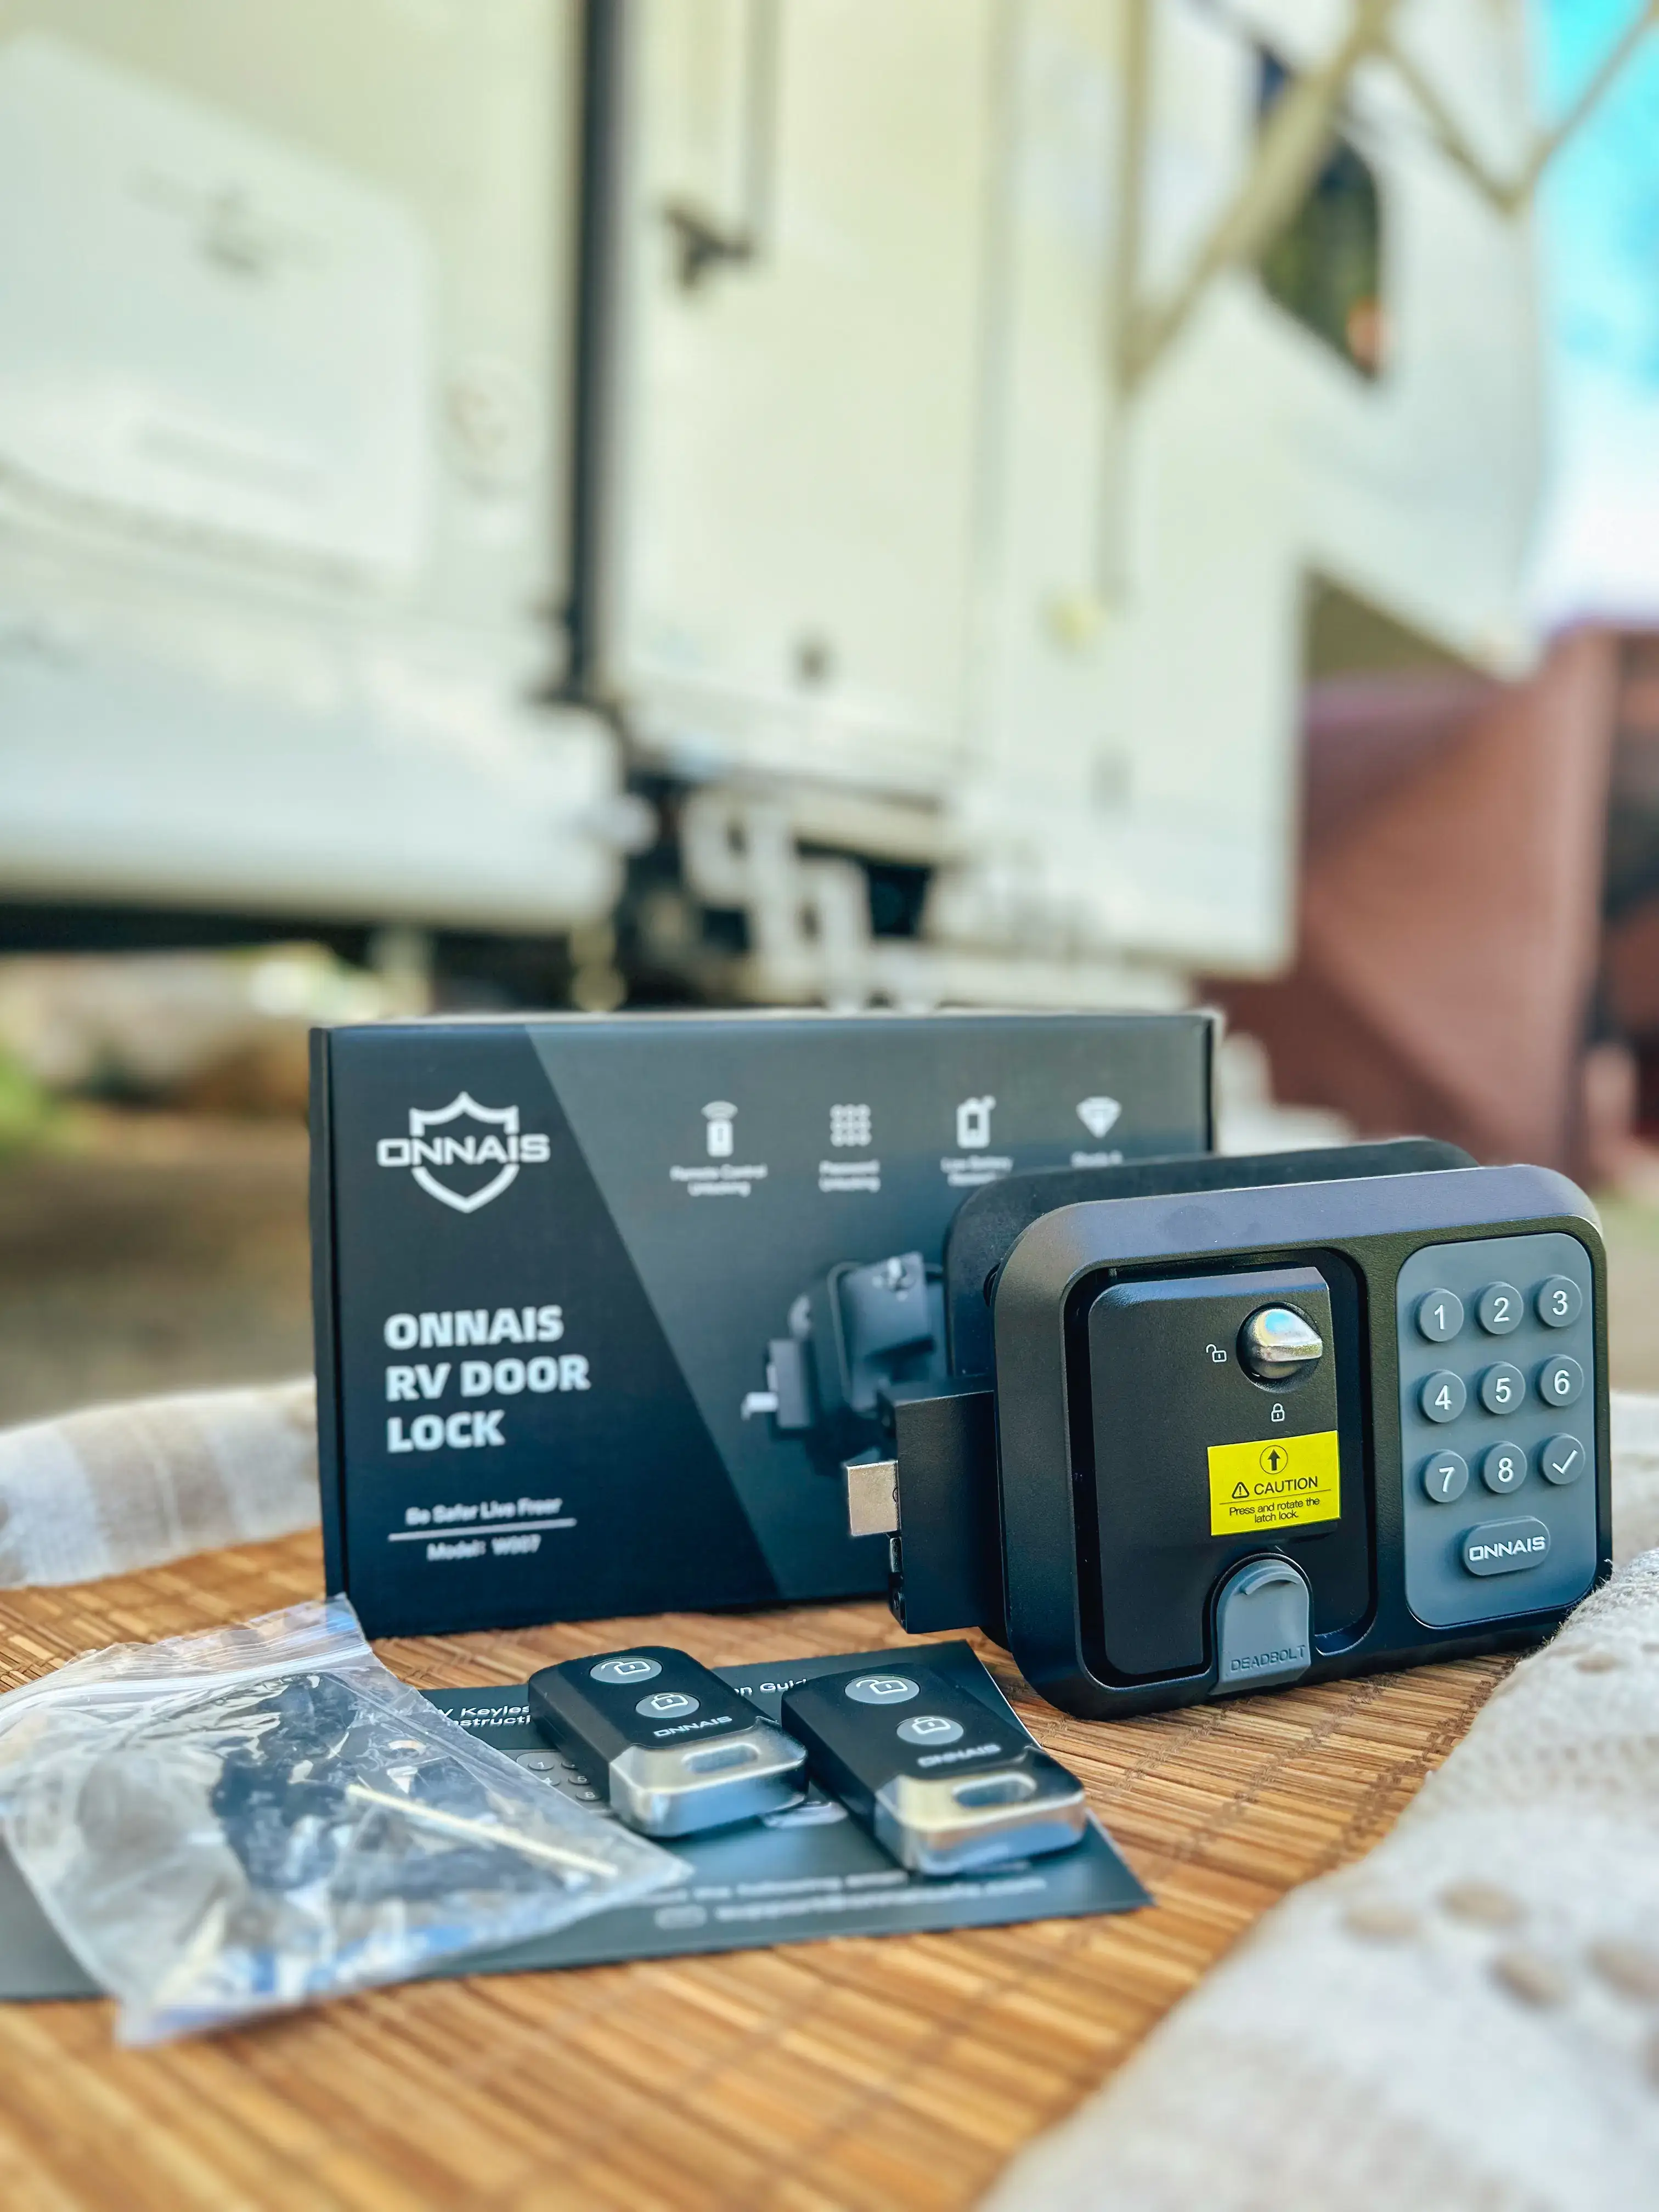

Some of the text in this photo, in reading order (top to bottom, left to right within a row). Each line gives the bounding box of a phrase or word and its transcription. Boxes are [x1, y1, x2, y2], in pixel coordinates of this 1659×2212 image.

[377, 1133, 551, 1167] ONNAIS
[1493, 1296, 1510, 1323] 2
[1553, 1290, 1568, 1316] 3
[384, 1305, 564, 1350] ONNAIS
[1434, 1305, 1445, 1330] 1
[386, 1354, 591, 1402] RV DOOR
[1495, 1377, 1511, 1403] 5
[1554, 1369, 1570, 1395] 6
[1435, 1385, 1452, 1410] 4
[387, 1409, 506, 1453] LOCK
[1438, 1466, 1454, 1493] 7
[1498, 1457, 1513, 1483] 8
[1254, 1476, 1318, 1495] CAUTION
[1229, 1497, 1320, 1516] Press and rotate the
[1254, 1510, 1299, 1523] latch lock.
[1469, 1536, 1545, 1562] ONNAIS
[1231, 1645, 1306, 1672] DEADBOLT
[460, 1705, 530, 1718] Keyles
[653, 1716, 733, 1738] ONNAIS
